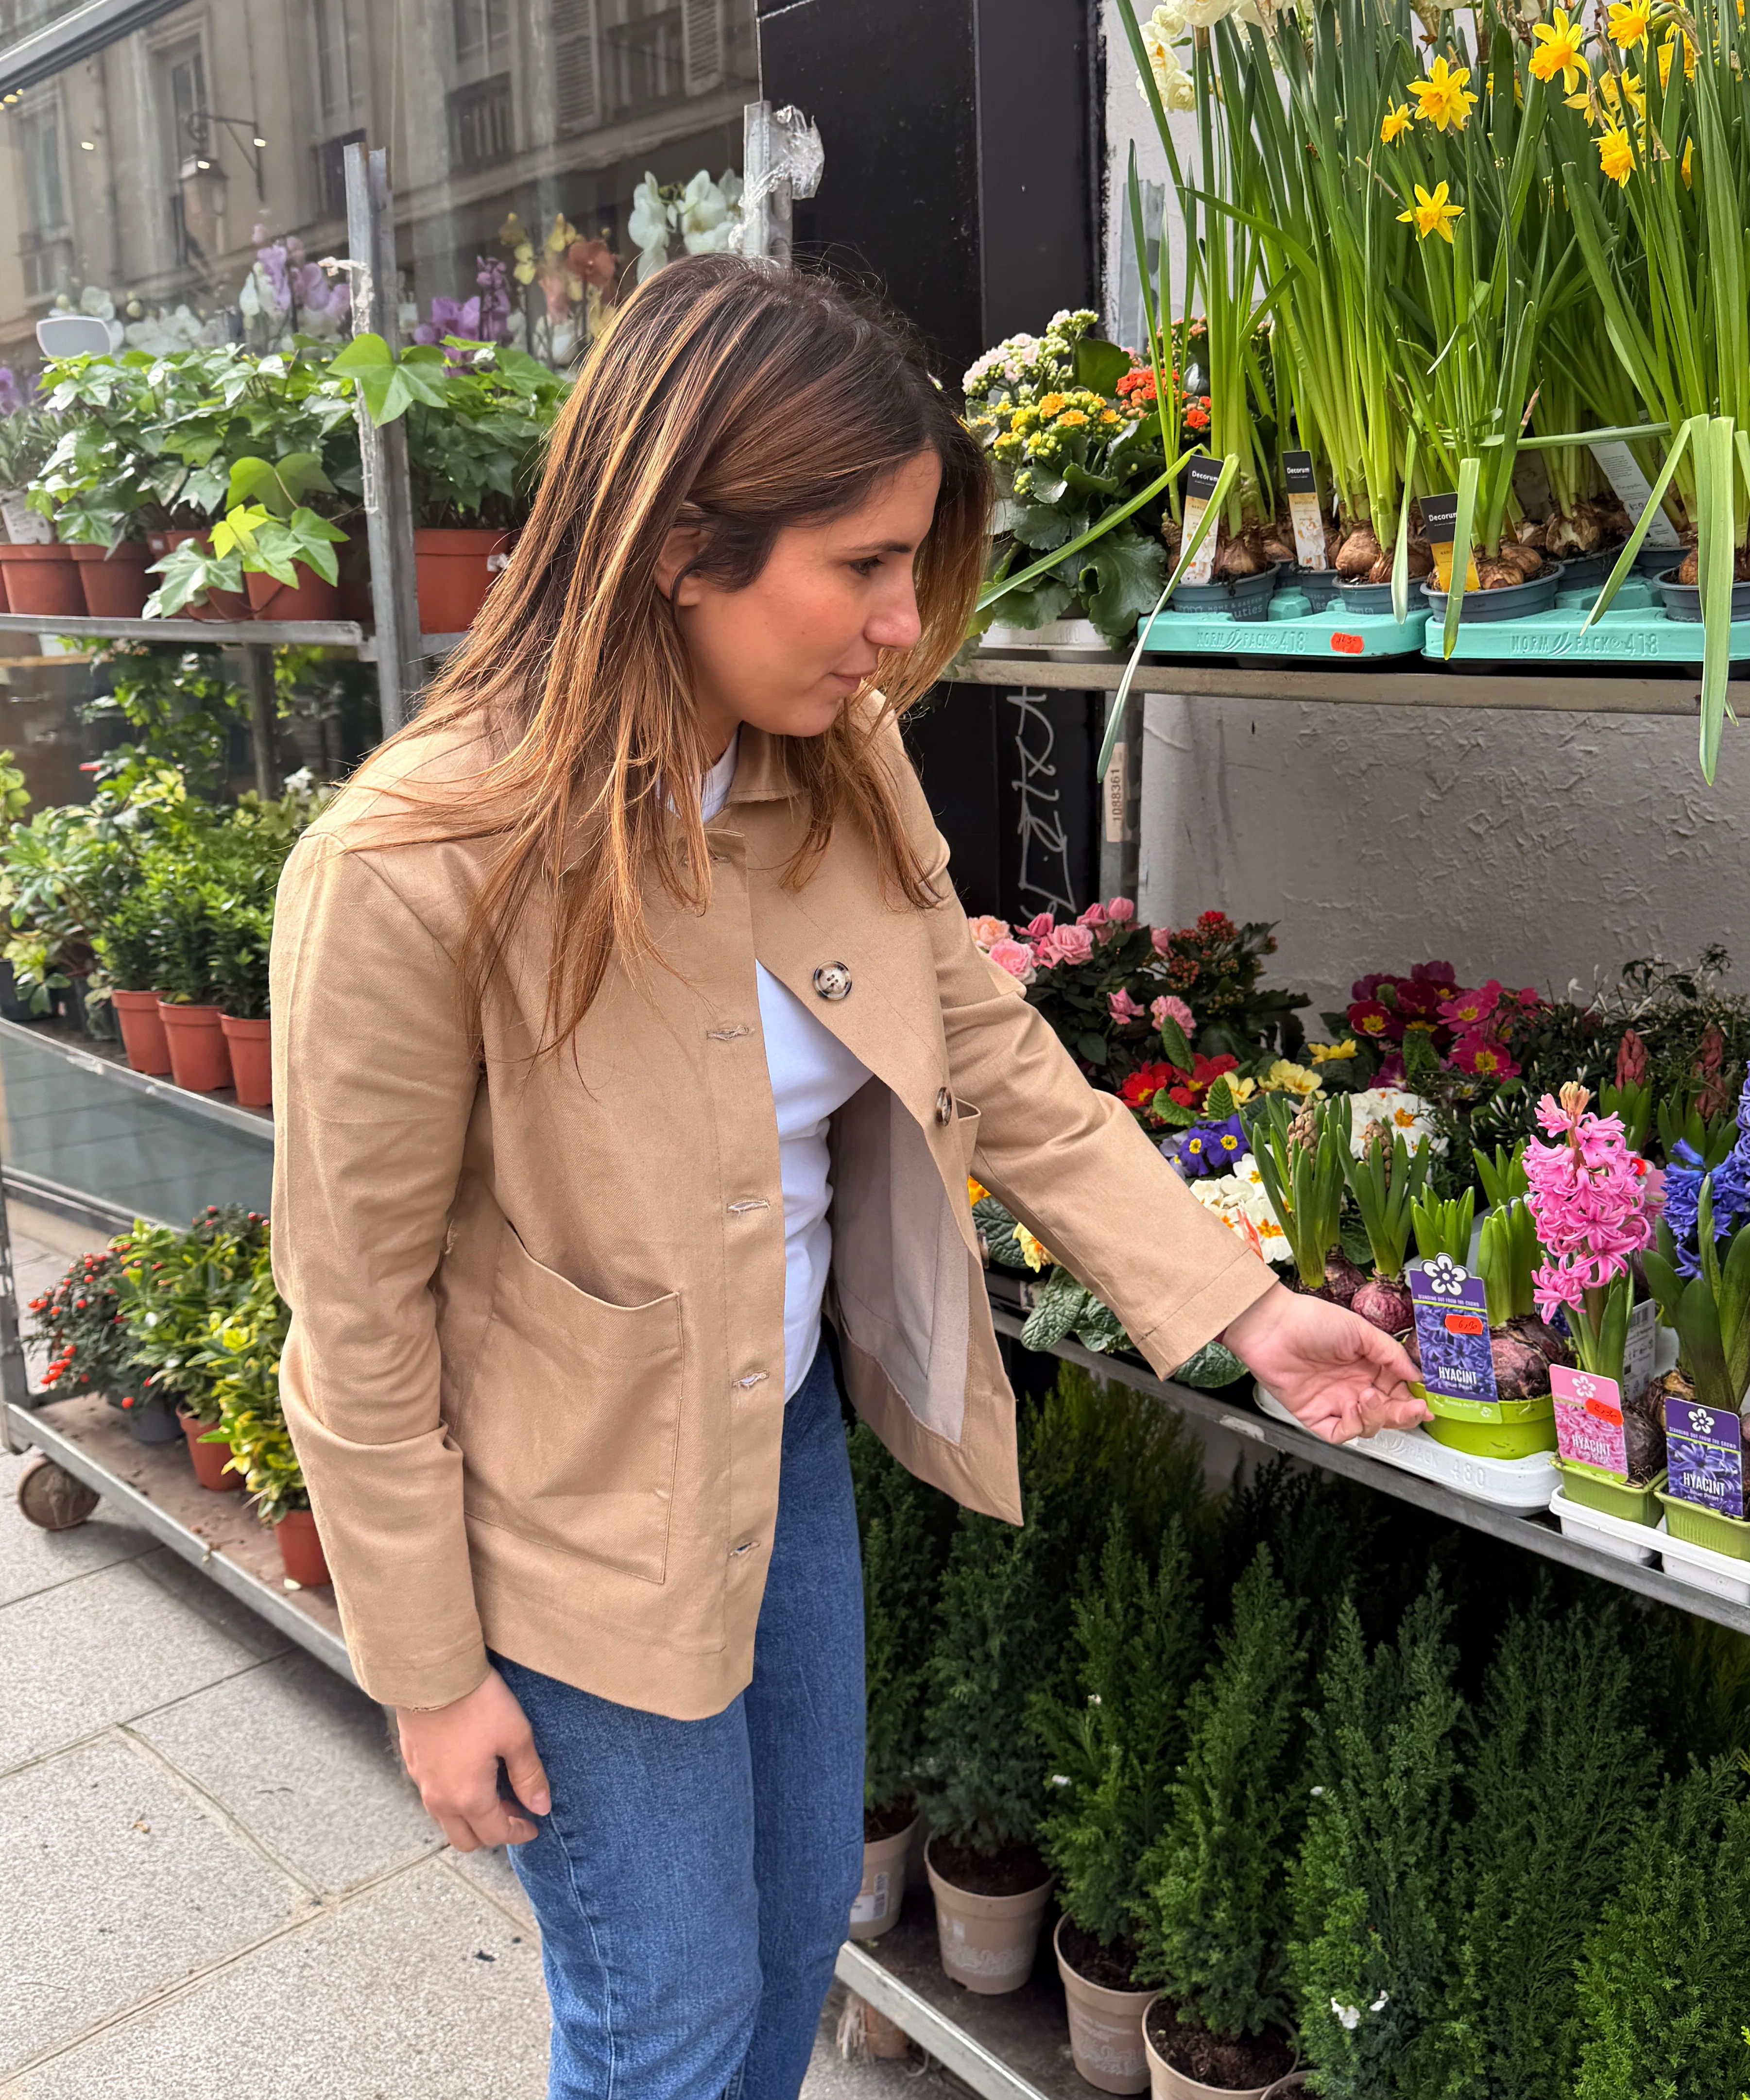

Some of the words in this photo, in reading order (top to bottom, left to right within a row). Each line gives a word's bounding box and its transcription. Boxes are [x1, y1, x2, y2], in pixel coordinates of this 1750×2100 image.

[1511, 635, 1550, 653] NORM
[1110, 769, 1123, 822] 1088361
[1438, 1366, 1477, 1384] HYACINT
[1572, 1434, 1611, 1456] HYACINT
[1683, 1471, 1725, 1496] HYACINT
